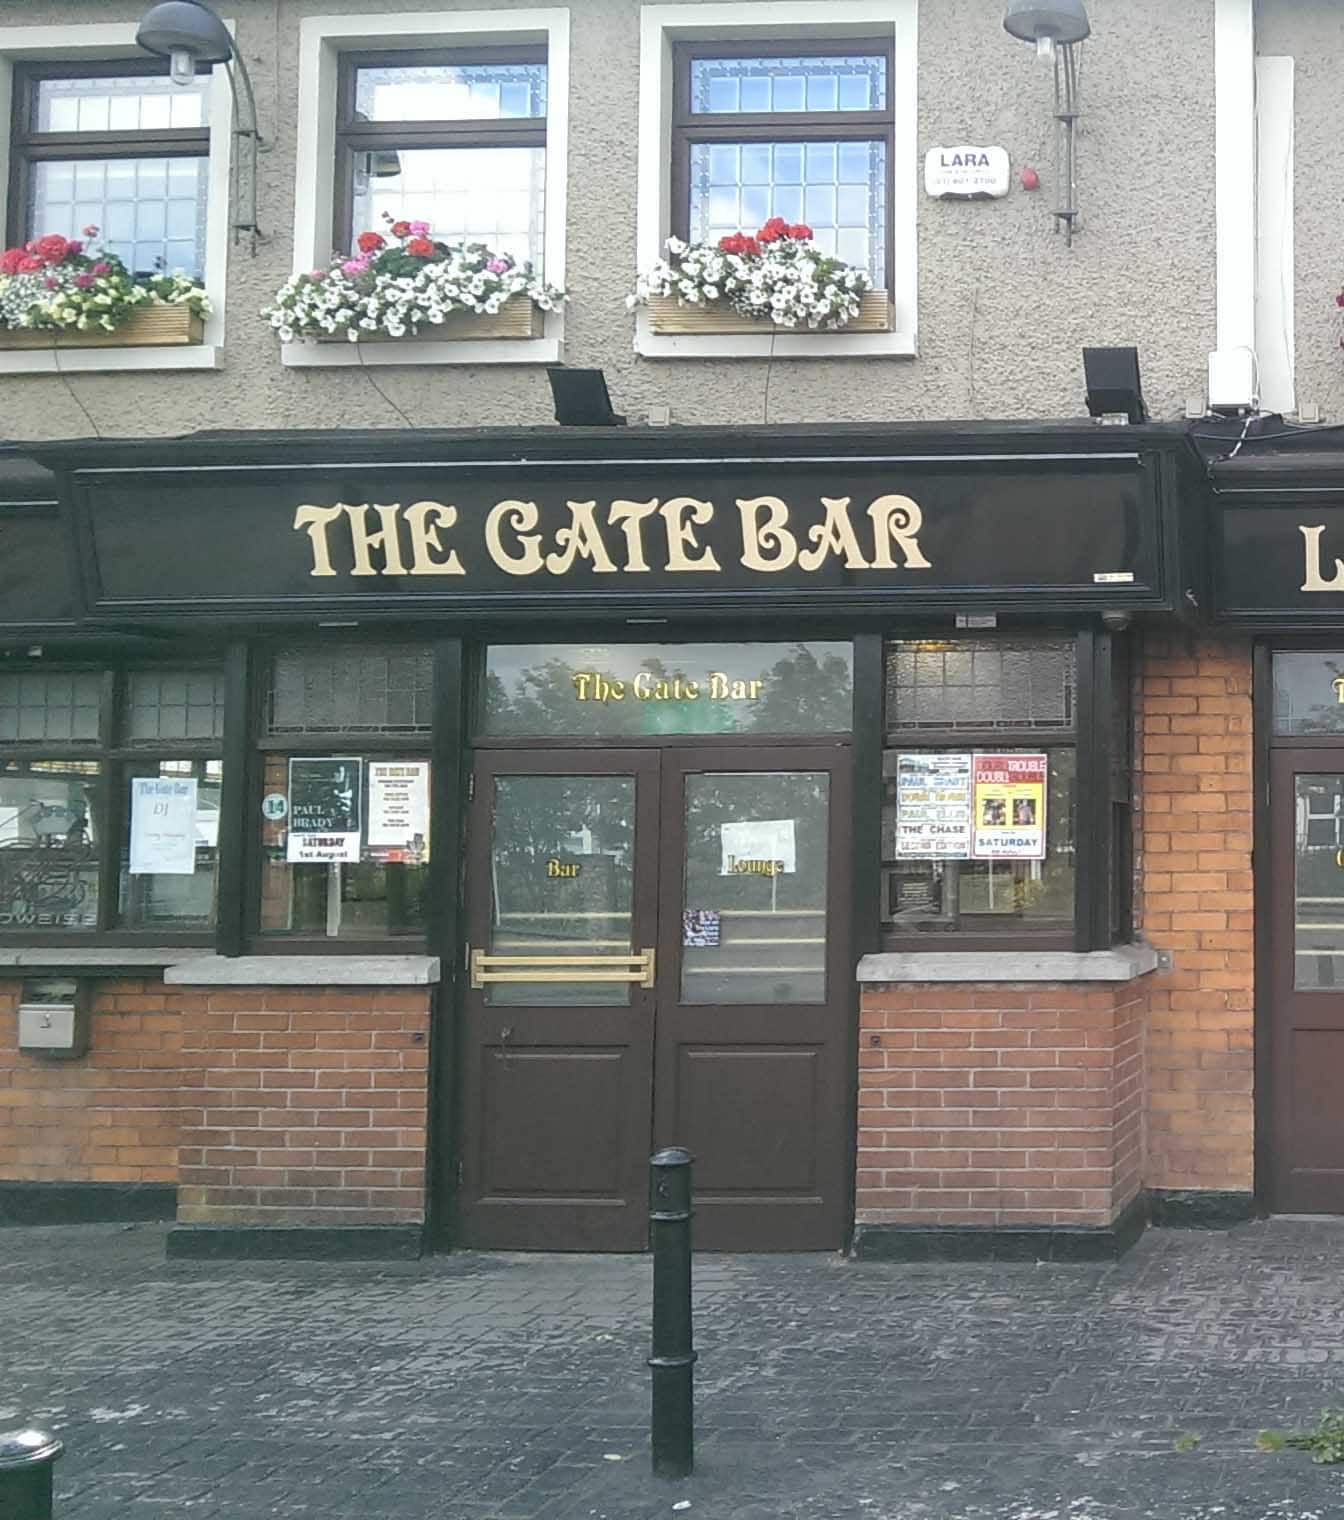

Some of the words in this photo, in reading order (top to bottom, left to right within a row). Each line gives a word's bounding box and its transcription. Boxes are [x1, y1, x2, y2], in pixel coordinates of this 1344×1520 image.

[940, 153, 990, 167] LARA
[294, 501, 466, 576] THE
[485, 498, 721, 575] GATE
[736, 495, 932, 573] BAR
[573, 672, 625, 705] The
[633, 672, 699, 700] Gate
[709, 671, 763, 700] Bar
[293, 805, 325, 815] PAUL
[293, 817, 333, 828] BRADY
[901, 825, 923, 833] THE
[929, 825, 965, 833] CHASE
[978, 838, 1038, 847] SATURDAY
[316, 851, 348, 860] August
[547, 858, 581, 878] Bar
[727, 855, 784, 879] Lounge
